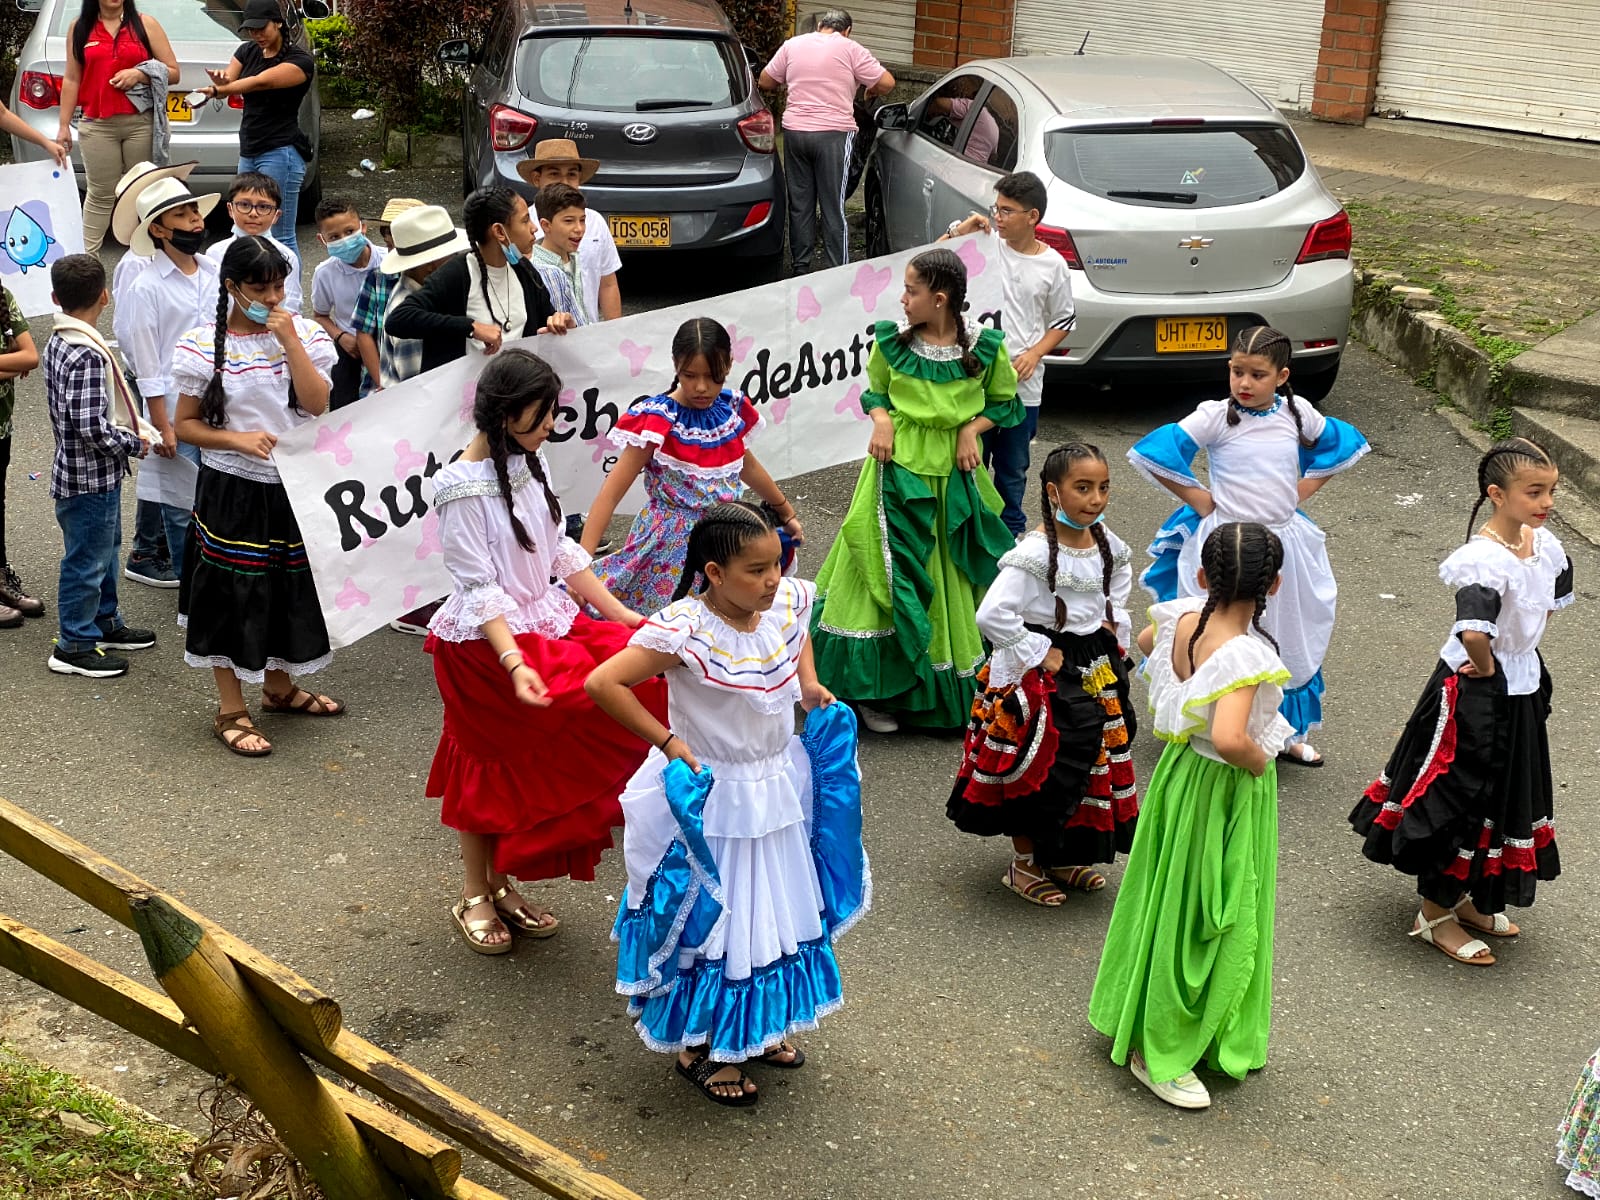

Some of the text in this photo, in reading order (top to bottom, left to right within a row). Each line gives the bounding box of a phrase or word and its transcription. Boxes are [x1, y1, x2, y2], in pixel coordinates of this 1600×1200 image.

[611, 221, 669, 239] IOS 058
[1159, 321, 1225, 342] JHT 730
